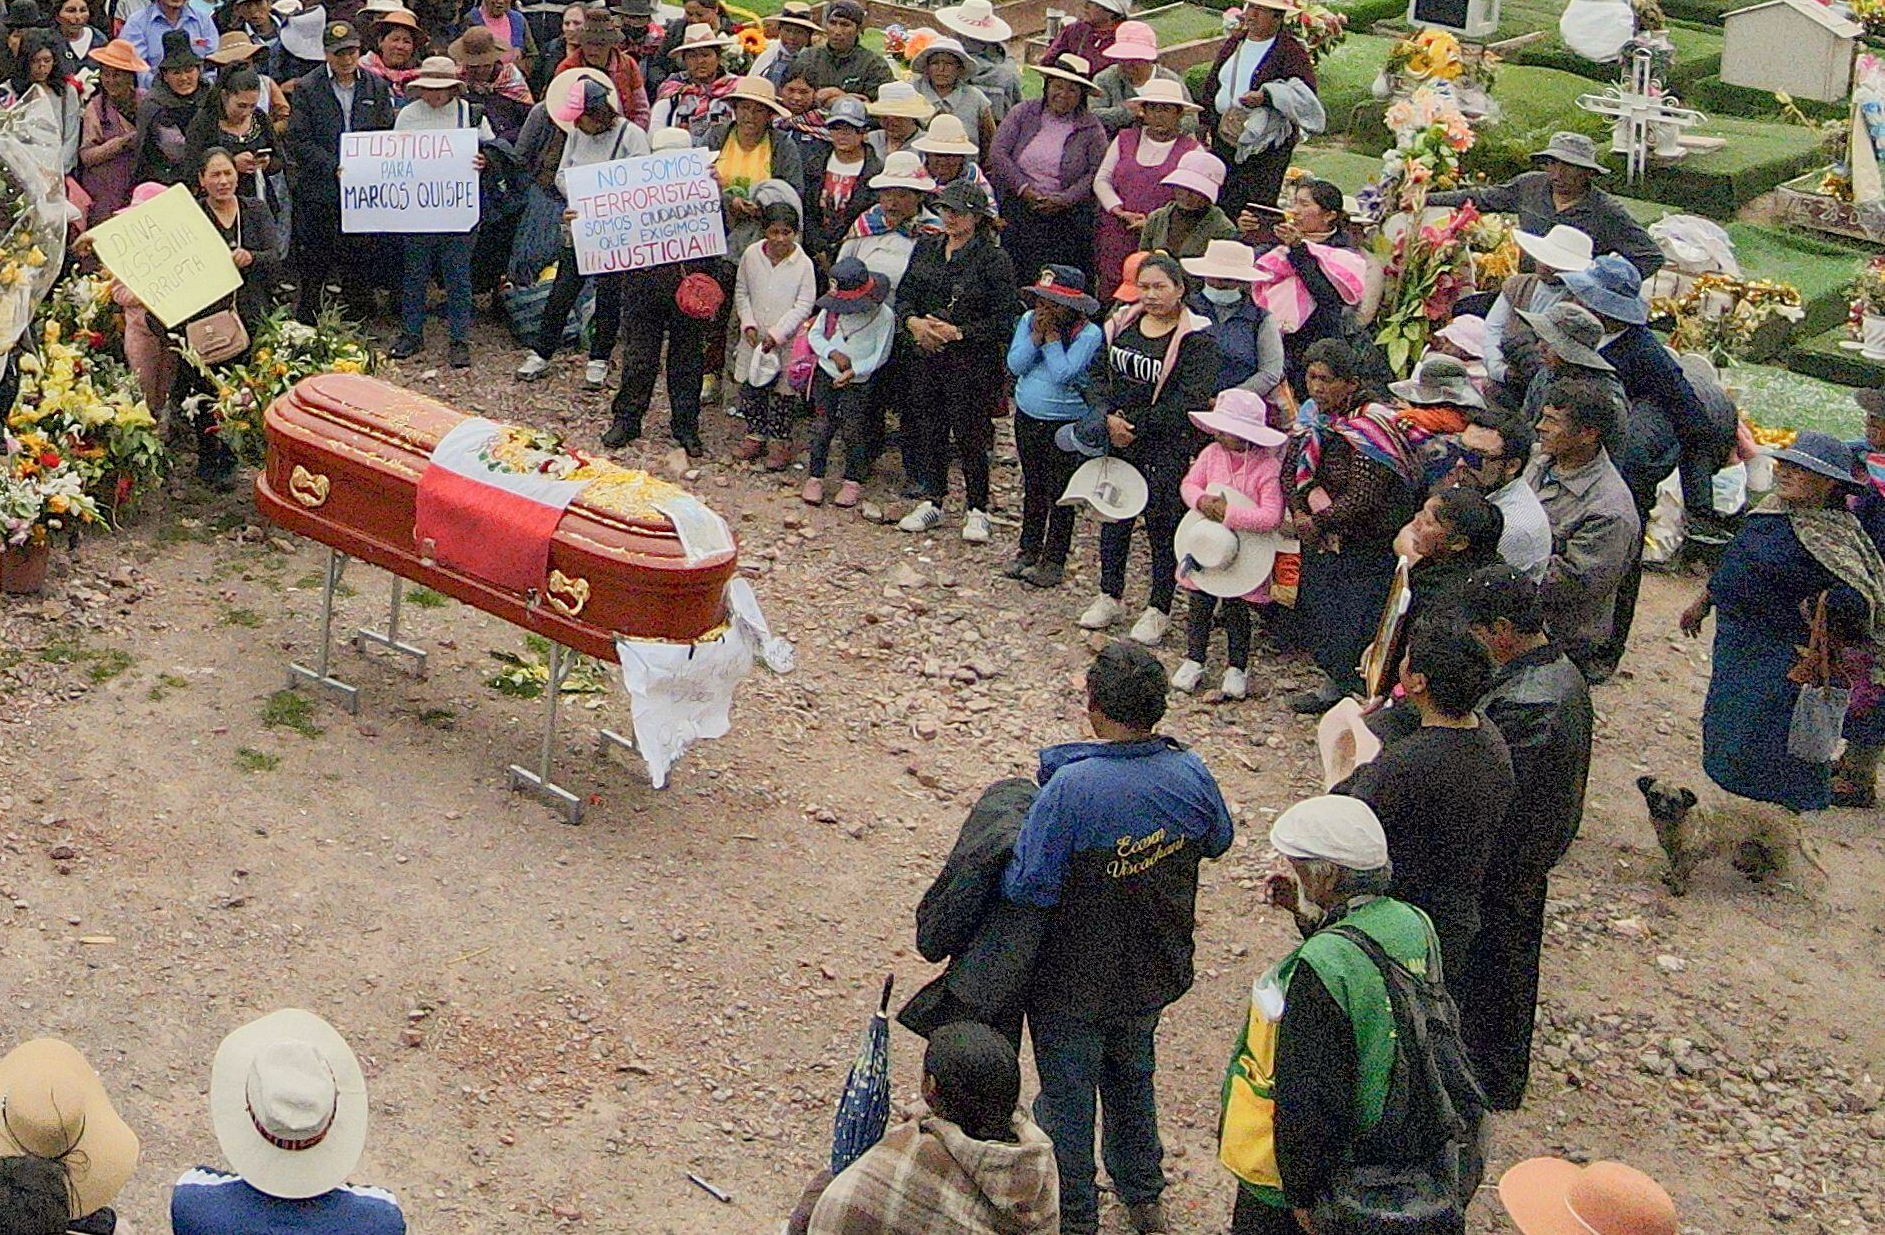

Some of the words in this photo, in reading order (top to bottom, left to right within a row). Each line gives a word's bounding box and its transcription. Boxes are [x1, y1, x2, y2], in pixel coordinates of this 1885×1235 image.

[345, 133, 453, 160] JUSTICIA
[381, 160, 414, 180] PARA
[598, 165, 627, 189] NO
[642, 153, 703, 183] SOMOS
[344, 182, 409, 210] MARCOS
[417, 181, 473, 208] QUISPE
[578, 180, 711, 219] TERRORISTAS
[110, 214, 162, 258] DINA
[584, 215, 632, 237] SOMOS
[640, 199, 720, 227] CIUDADANOS
[599, 233, 630, 250] QUE
[640, 217, 710, 242] EXIGIMOS
[122, 221, 198, 284] ASESINA
